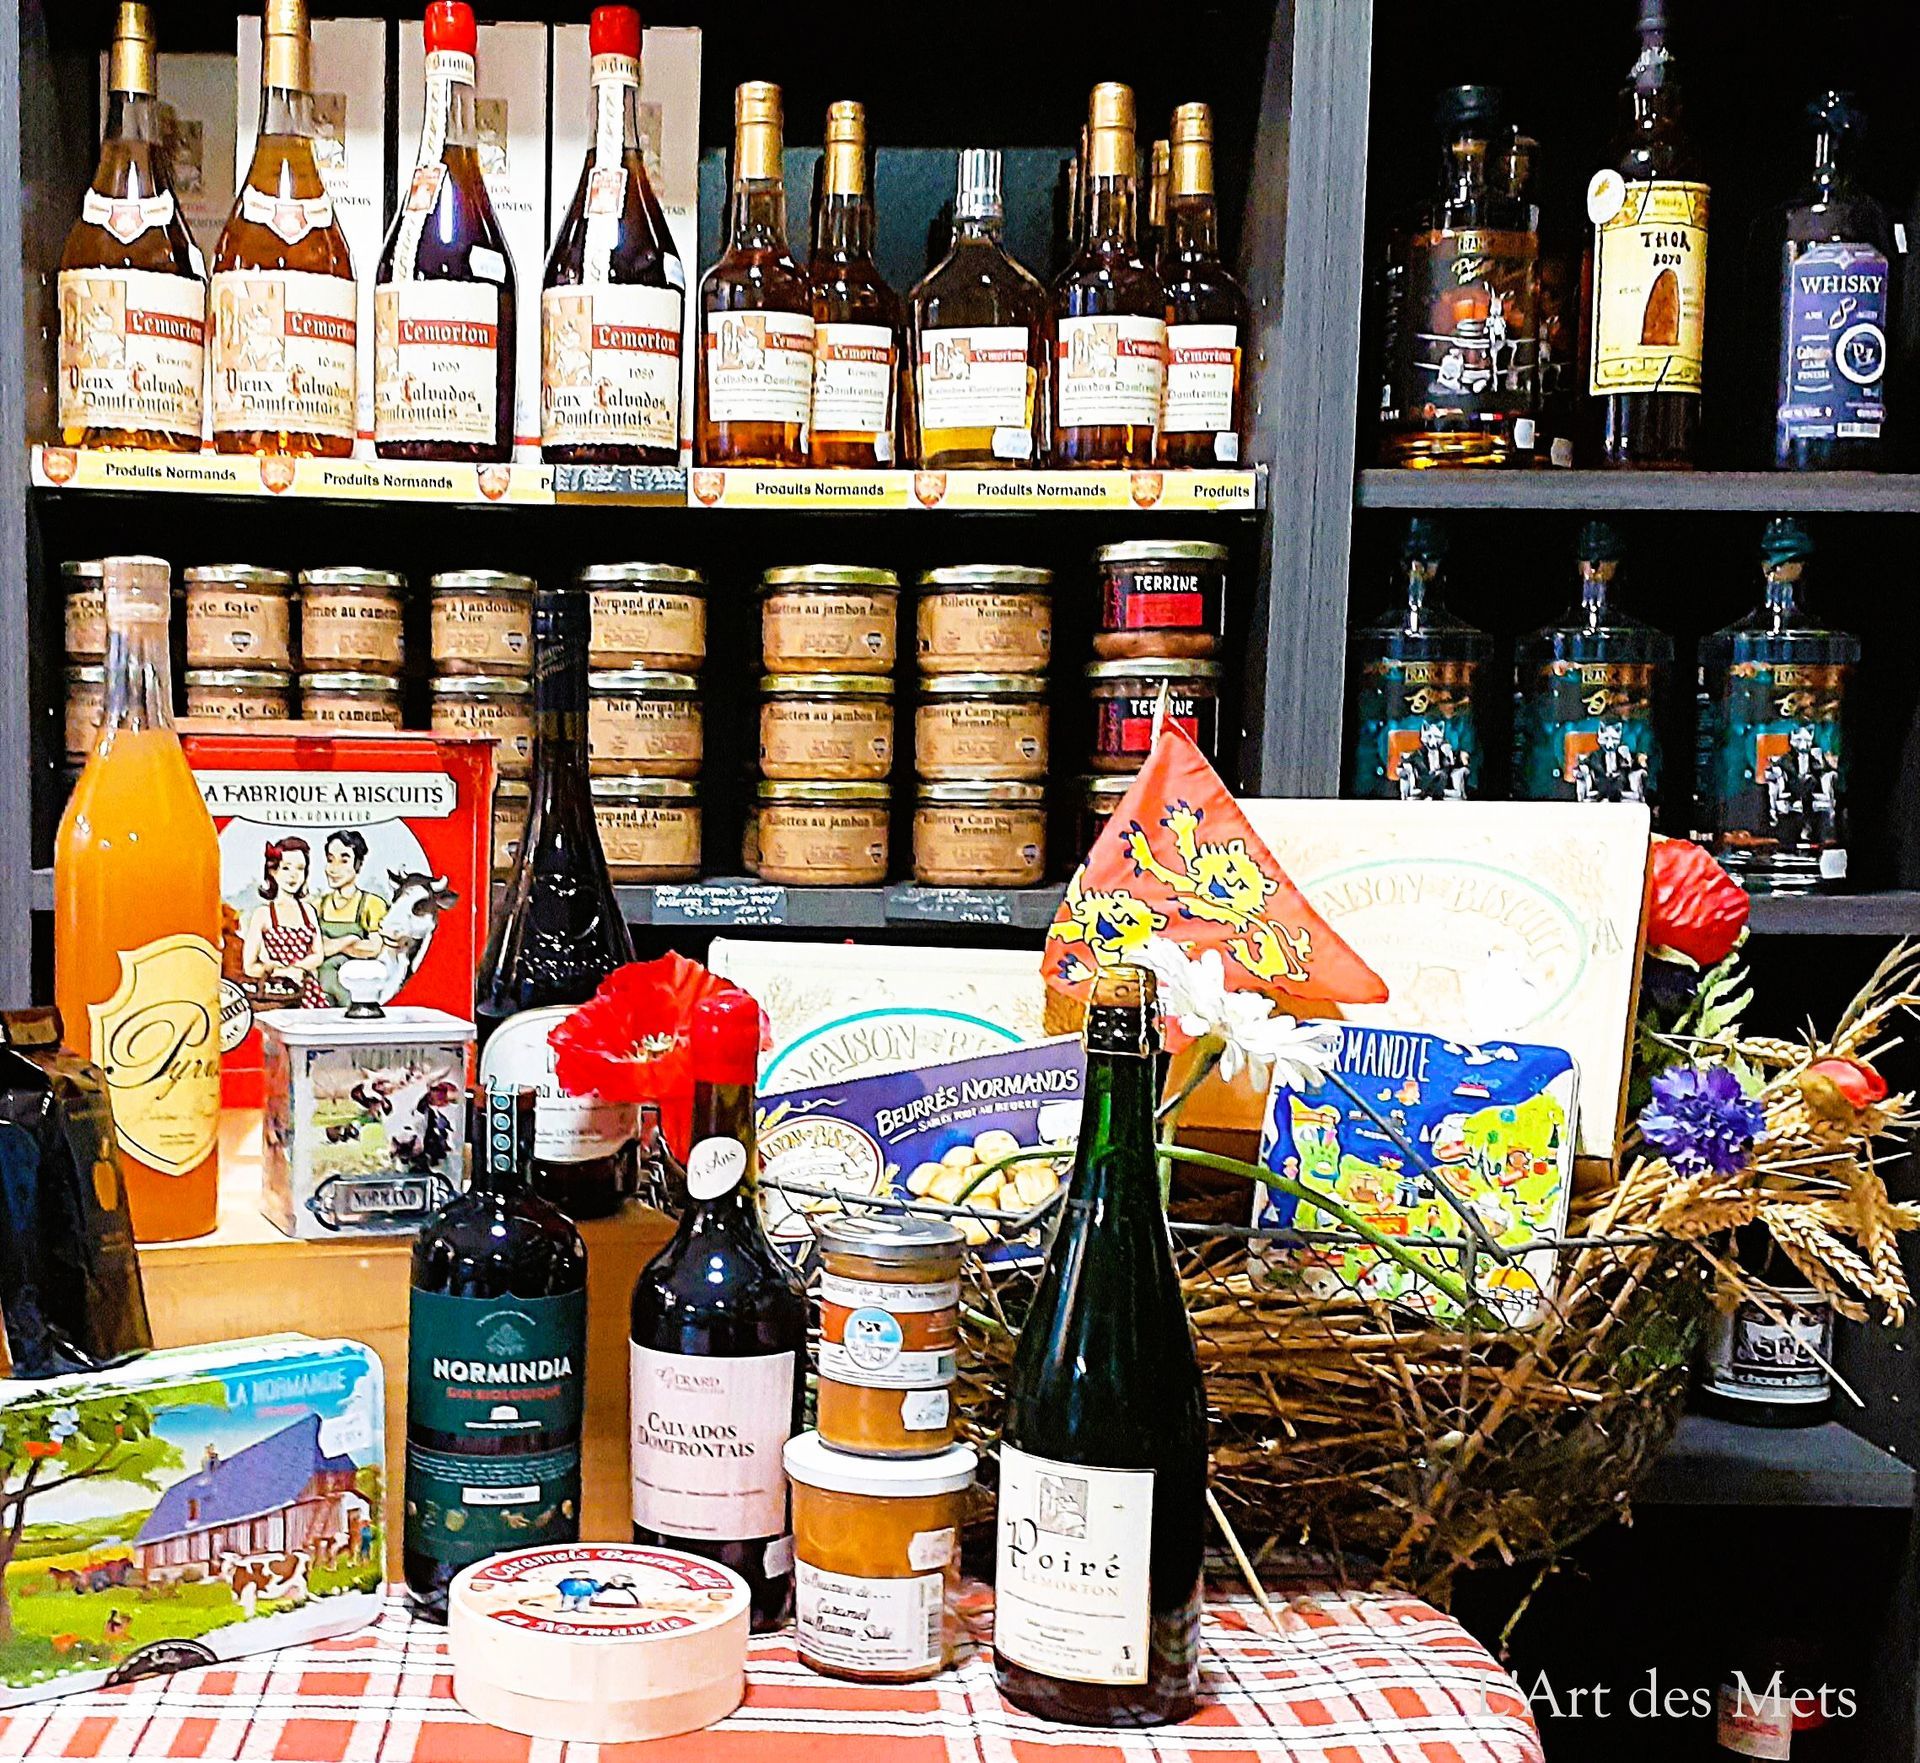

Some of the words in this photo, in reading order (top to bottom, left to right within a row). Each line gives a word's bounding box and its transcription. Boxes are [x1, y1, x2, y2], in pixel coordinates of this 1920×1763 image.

[1641, 231, 1691, 252] THOR
[1801, 275, 1882, 294] WHISKY
[404, 317, 489, 344] Lemorton
[599, 325, 676, 350] Lemorton
[105, 463, 163, 479] Produits
[166, 465, 236, 481] Normands
[323, 472, 380, 488] Produits
[383, 474, 453, 489] Normands
[755, 482, 812, 496] Produits
[815, 483, 884, 497] Normands
[977, 483, 1033, 496] Produits
[1036, 483, 1107, 497] Normands
[1193, 484, 1250, 498] Produits
[1134, 574, 1198, 592] TERRINE
[224, 601, 260, 613] foie
[593, 597, 643, 612] Normand
[823, 603, 867, 617] jambon
[831, 708, 873, 724] jambon
[1130, 699, 1194, 716] TERINE
[223, 785, 328, 804] FABRIQUE
[352, 785, 444, 804] BISCUITS
[1330, 1029, 1434, 1083] RMANDIE
[875, 1085, 959, 1138] BEURRÉS
[962, 1068, 1080, 1104] NORMANDS
[433, 1356, 573, 1384] NORMINDIA
[648, 1412, 738, 1440] CALVADOS
[637, 1424, 756, 1458] DOMFRONTAIS
[1006, 1518, 1121, 1580] Poiré
[485, 1548, 592, 1581] Caramels
[529, 1617, 683, 1637] Normandie
